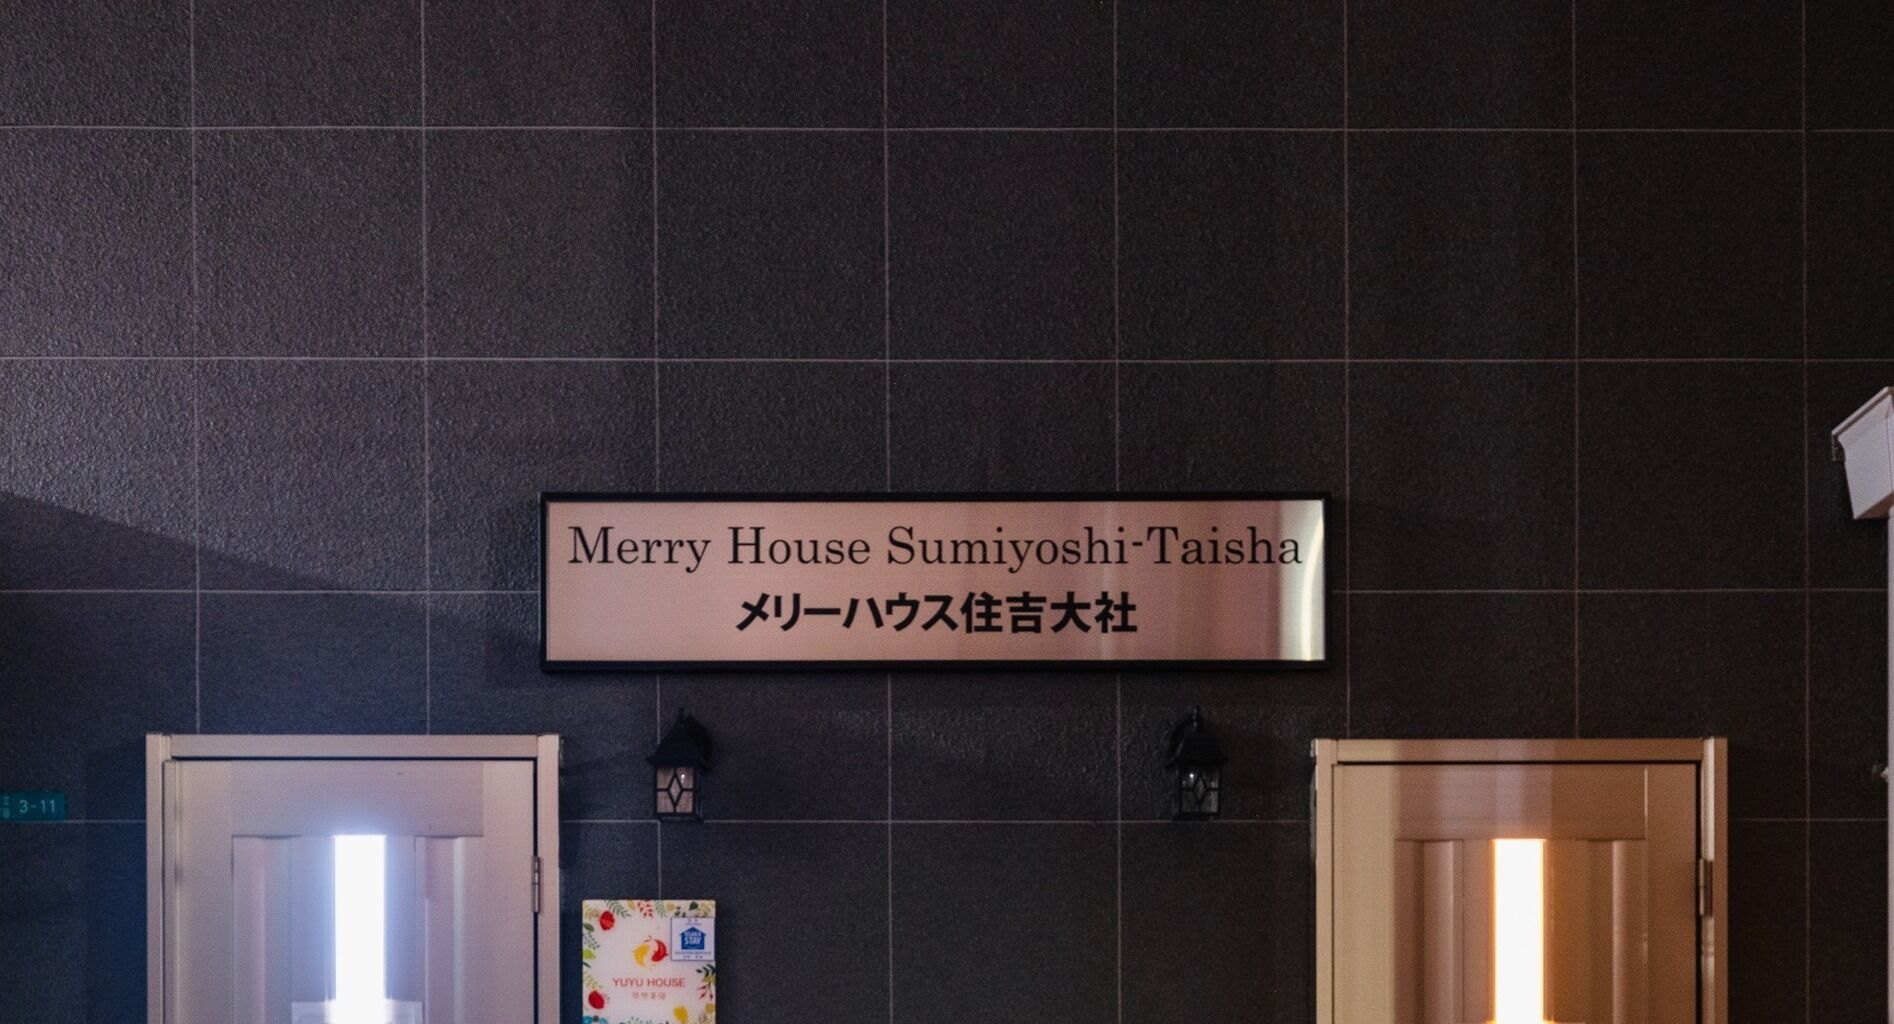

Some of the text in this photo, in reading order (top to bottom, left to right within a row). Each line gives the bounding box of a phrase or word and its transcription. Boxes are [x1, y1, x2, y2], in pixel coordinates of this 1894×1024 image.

[566, 525, 1302, 574] Merry House Sumiyoshi-Taisha
[735, 590, 1138, 634] メリーハウス住吉大社
[18, 799, 56, 814] 3-11
[612, 977, 686, 988] YUYU HOUSE
